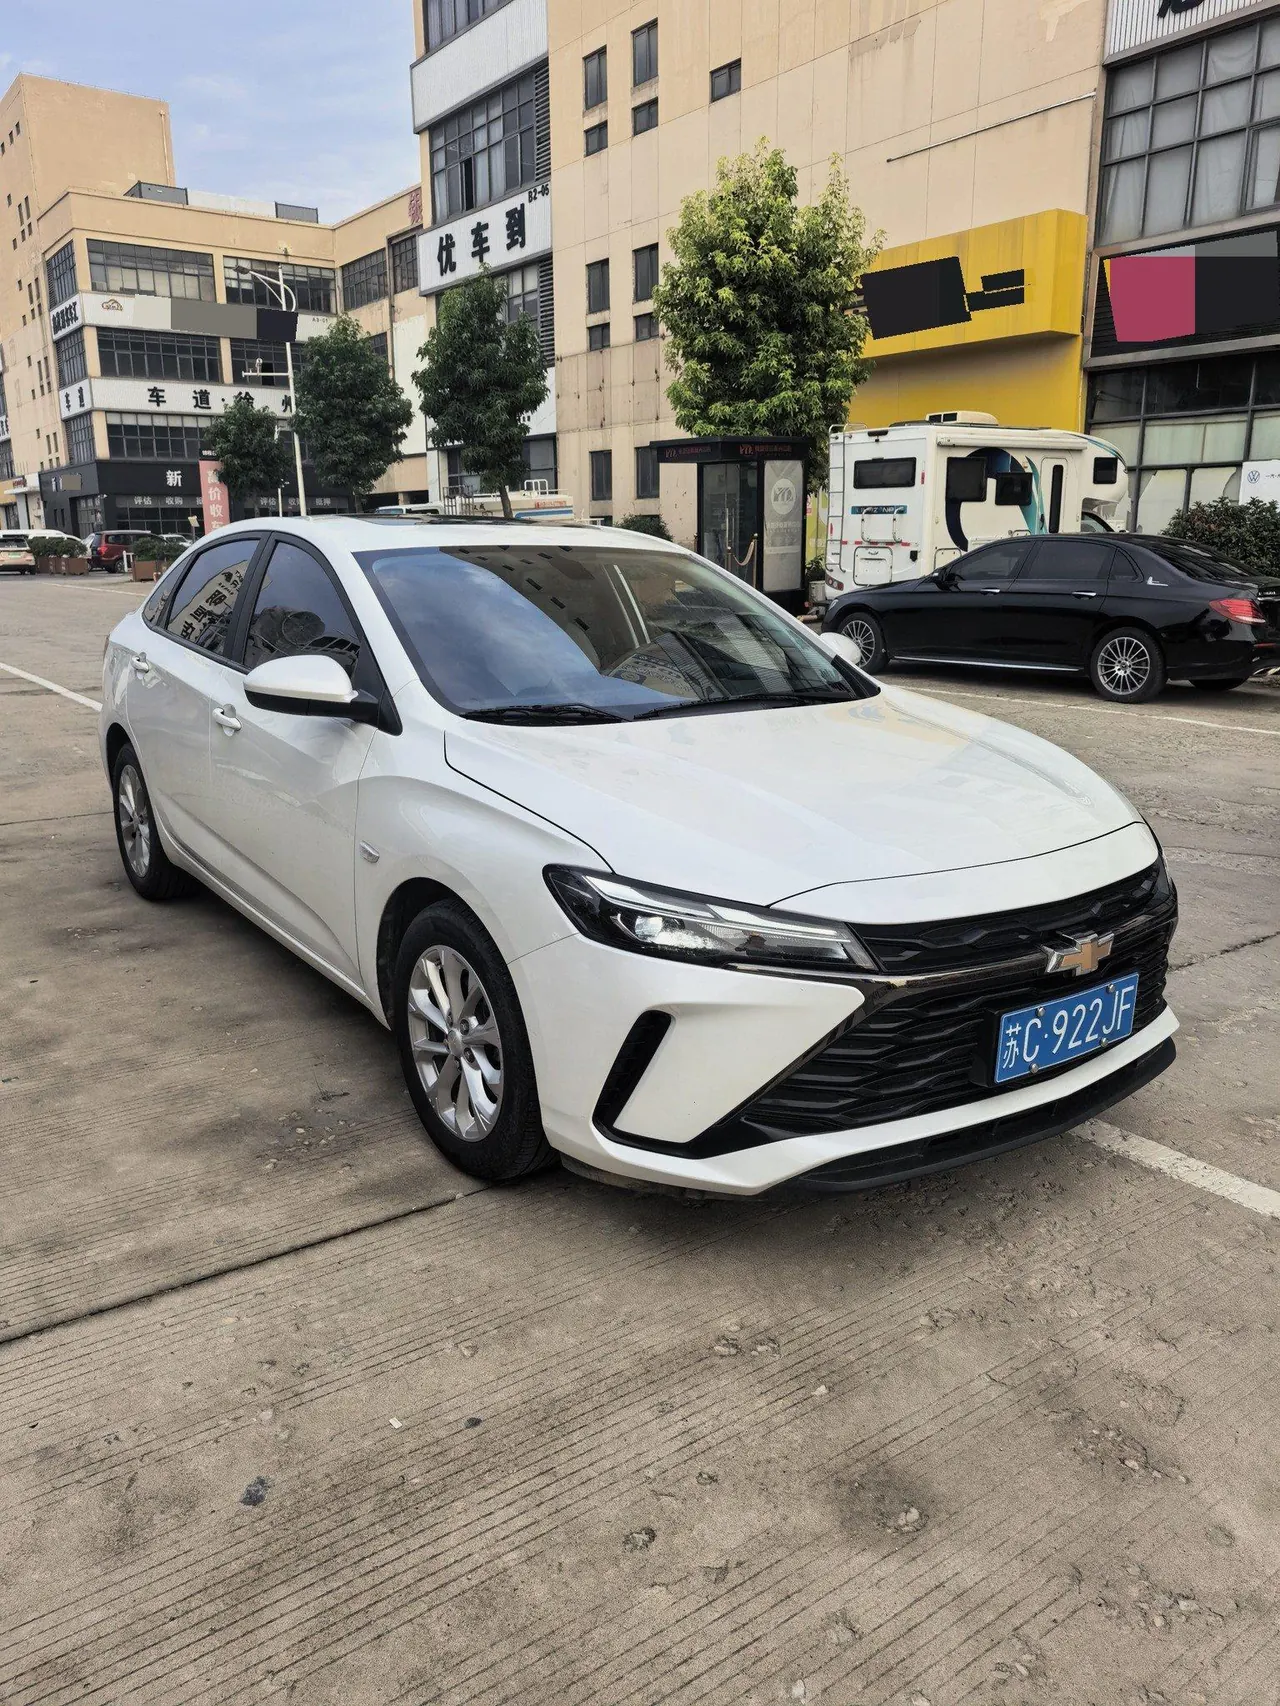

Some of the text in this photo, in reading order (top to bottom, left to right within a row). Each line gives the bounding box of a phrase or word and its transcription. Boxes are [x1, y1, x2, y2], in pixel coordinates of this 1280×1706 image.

[528, 184, 550, 203] B2-05
[437, 202, 526, 277] 优车到
[166, 469, 182, 488] 新
[133, 495, 152, 506] 评估
[165, 496, 183, 506] 收购
